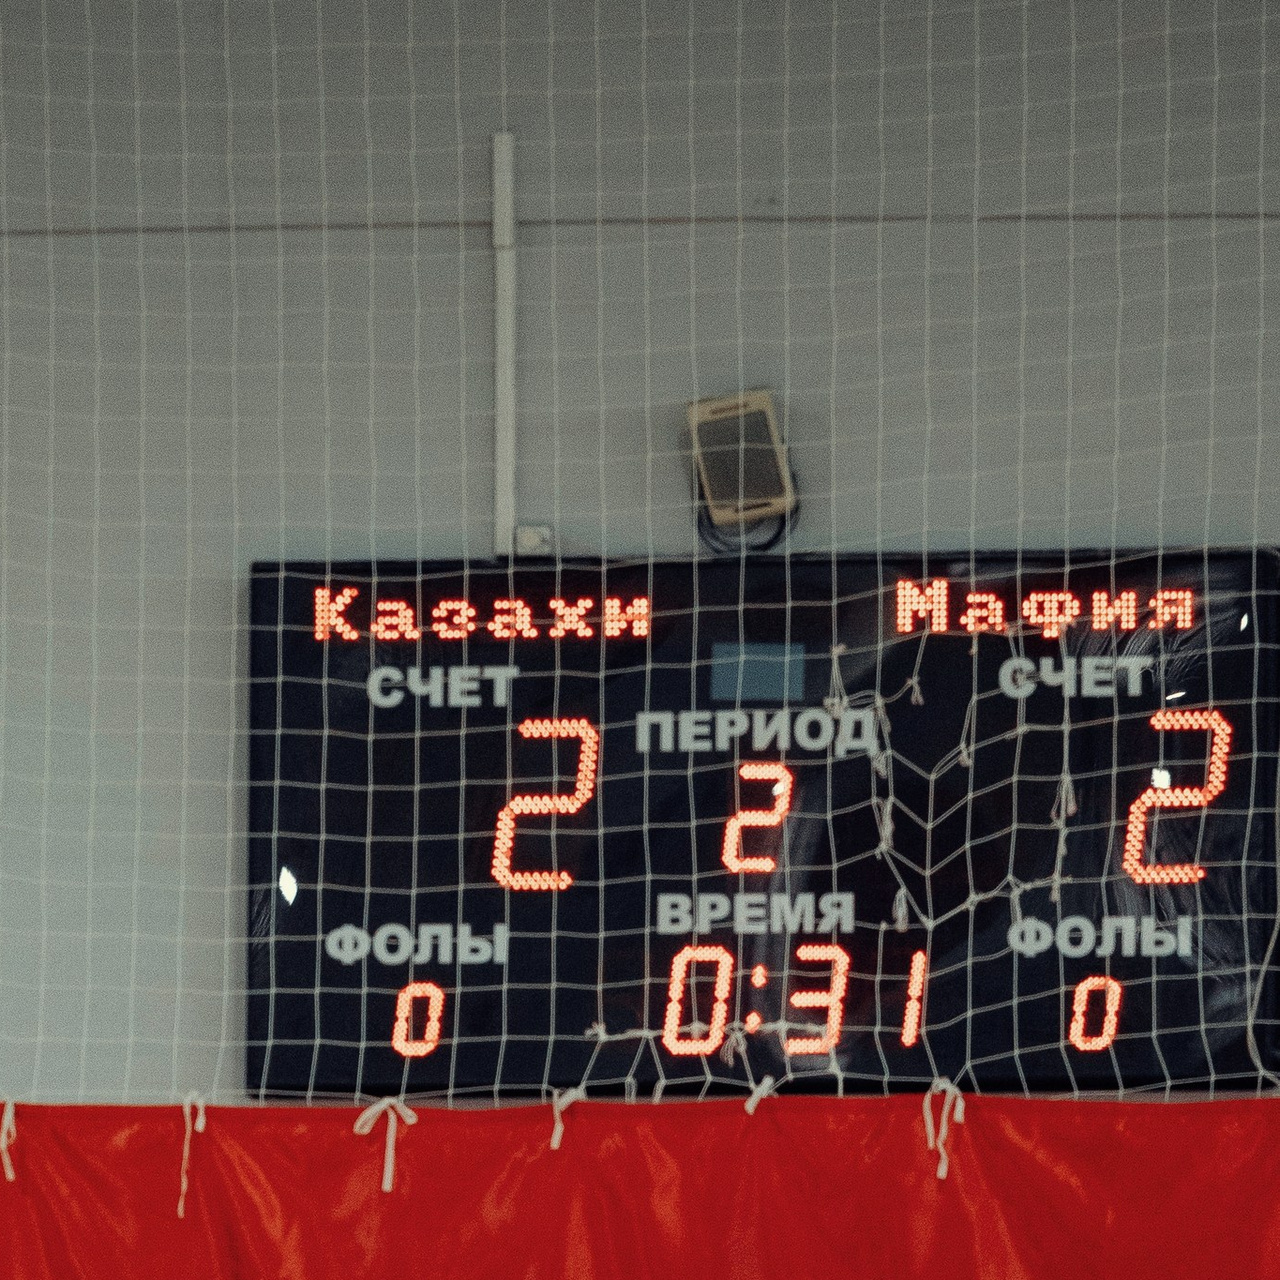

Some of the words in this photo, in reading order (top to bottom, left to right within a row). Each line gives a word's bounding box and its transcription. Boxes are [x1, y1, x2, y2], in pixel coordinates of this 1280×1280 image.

[314, 587, 650, 641] Казахи
[896, 578, 1194, 638] Мафия
[367, 665, 520, 710] СЧЕТ
[998, 655, 1154, 700] СЧЕТ
[637, 708, 880, 758] ПЕРИОД
[491, 718, 598, 891] 2
[723, 761, 794, 873] 2
[1123, 710, 1232, 883] 2
[656, 892, 856, 936] ВРЕМЯ
[1006, 915, 1193, 960] ФОЛЫ
[325, 921, 510, 966] ФОЛЫ
[391, 981, 445, 1058] 0
[662, 944, 927, 1057] 0:31
[1068, 976, 1122, 1053] 0
